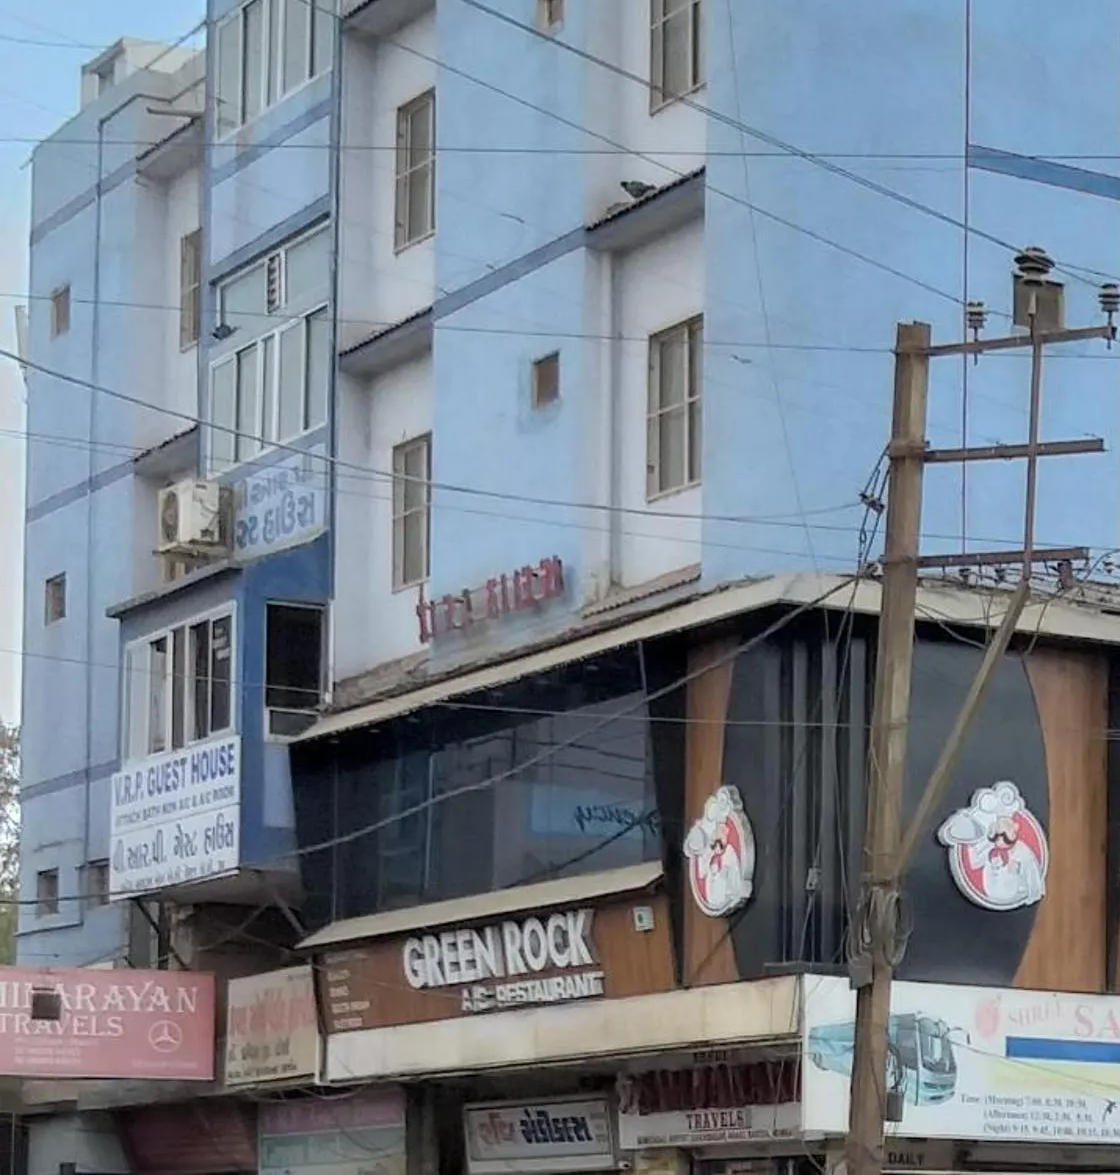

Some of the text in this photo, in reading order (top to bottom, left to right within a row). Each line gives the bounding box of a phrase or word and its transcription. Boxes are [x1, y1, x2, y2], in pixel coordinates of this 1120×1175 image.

[147, 756, 188, 798] GUEST
[190, 743, 235, 786] HOUSE
[403, 908, 595, 989] GREEN ROCK
[1008, 1000, 1063, 1026] SHREE
[686, 1110, 745, 1130] TRAVELS
